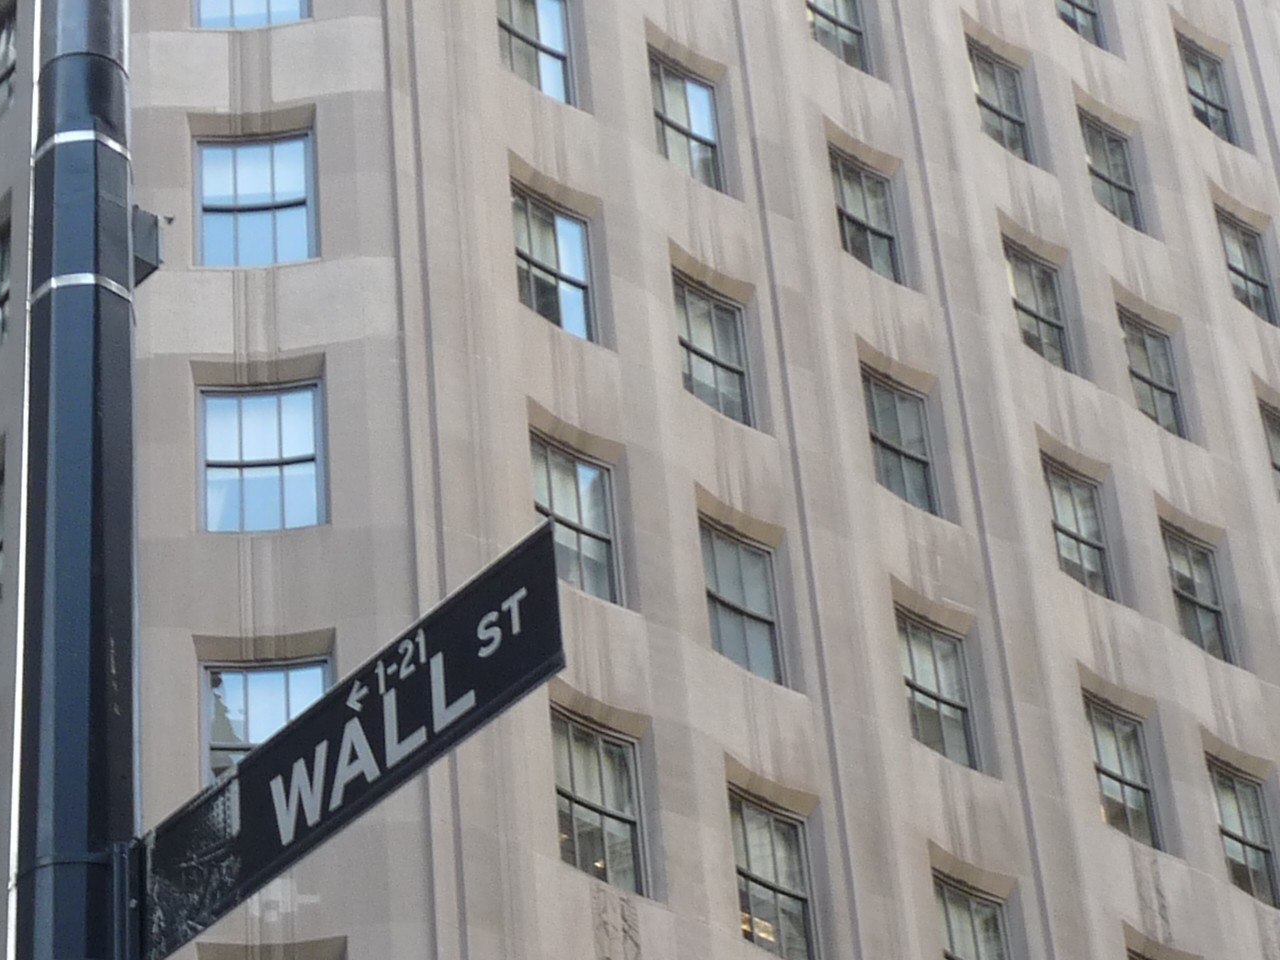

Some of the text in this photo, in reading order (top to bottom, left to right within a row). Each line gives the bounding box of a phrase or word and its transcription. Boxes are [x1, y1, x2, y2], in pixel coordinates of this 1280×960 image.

[270, 587, 527, 846] WALL ST
[375, 629, 426, 694] 1-21
